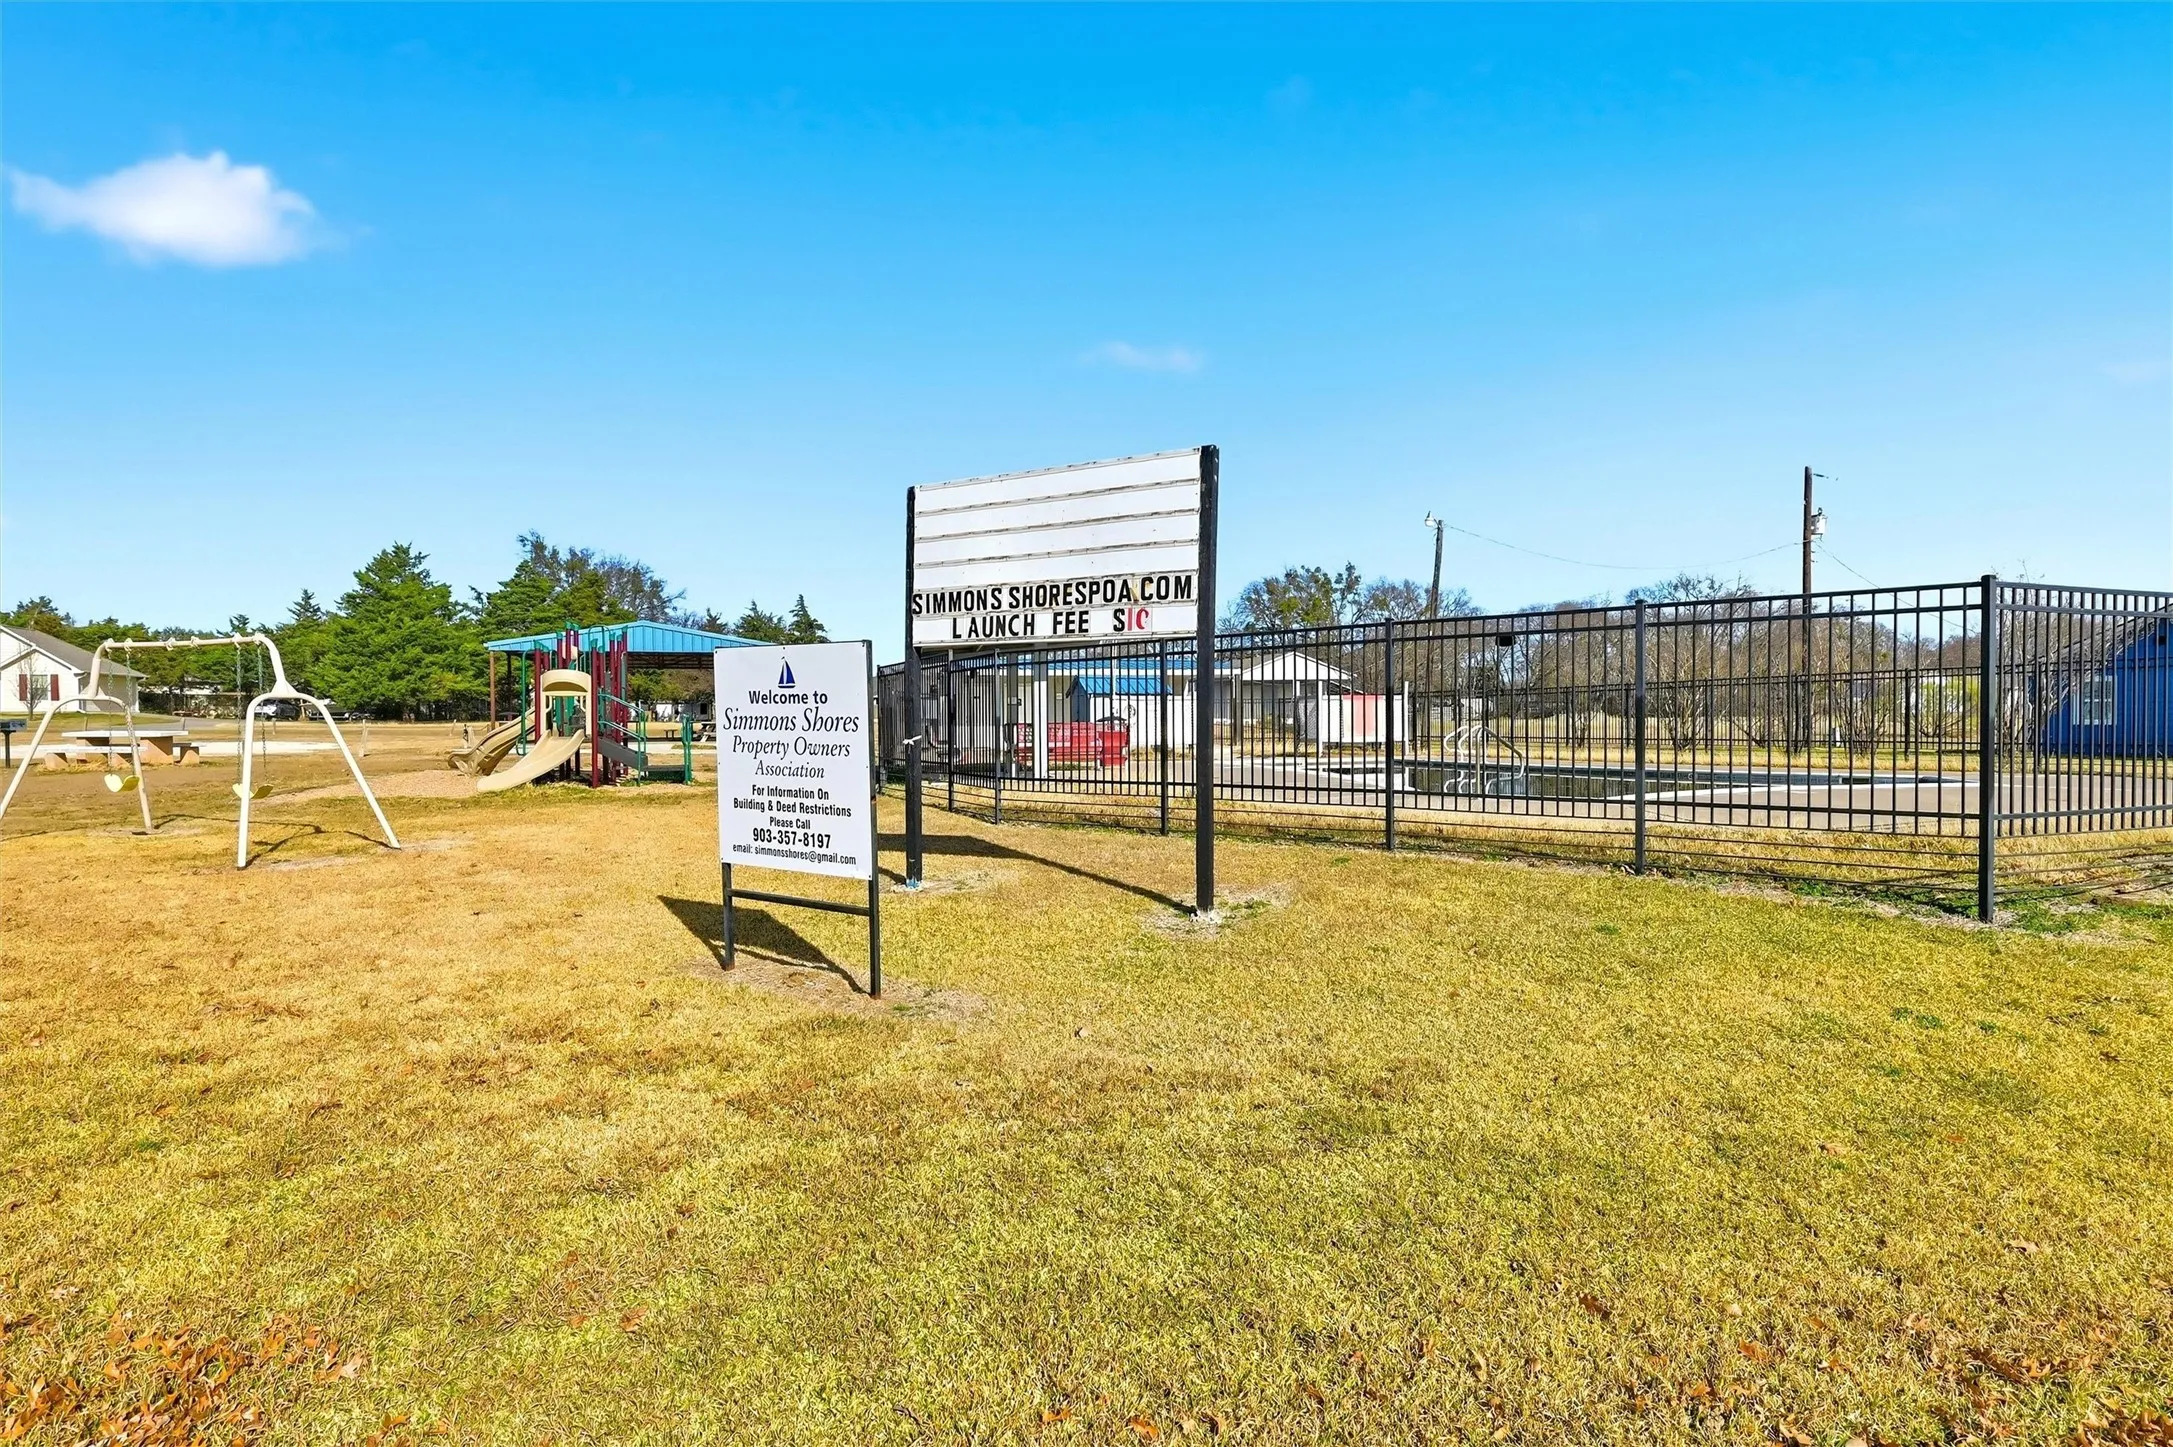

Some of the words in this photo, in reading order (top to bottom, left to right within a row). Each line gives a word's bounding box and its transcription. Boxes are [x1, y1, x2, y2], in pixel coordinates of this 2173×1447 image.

[952, 613, 1035, 639] LAUNCH
[1053, 610, 1089, 635] FEE
[749, 691, 809, 705] Welcome
[813, 691, 828, 705] to
[723, 707, 796, 732] Simmons
[802, 706, 859, 733] Shores
[733, 735, 789, 760] Property
[794, 737, 850, 757] Owners
[755, 760, 825, 778] Association
[752, 785, 765, 796] For
[767, 786, 815, 800] Information
[818, 788, 829, 800] On
[734, 798, 765, 812] Building
[768, 801, 773, 811] &
[776, 802, 796, 813] Deed
[799, 803, 852, 817] Restrictions
[769, 816, 793, 827] Please
[795, 819, 811, 829] Call
[752, 828, 831, 849] 903-357-8197
[733, 844, 753, 854] email:
[754, 845, 856, 865] simmonsshores@gmail.com
